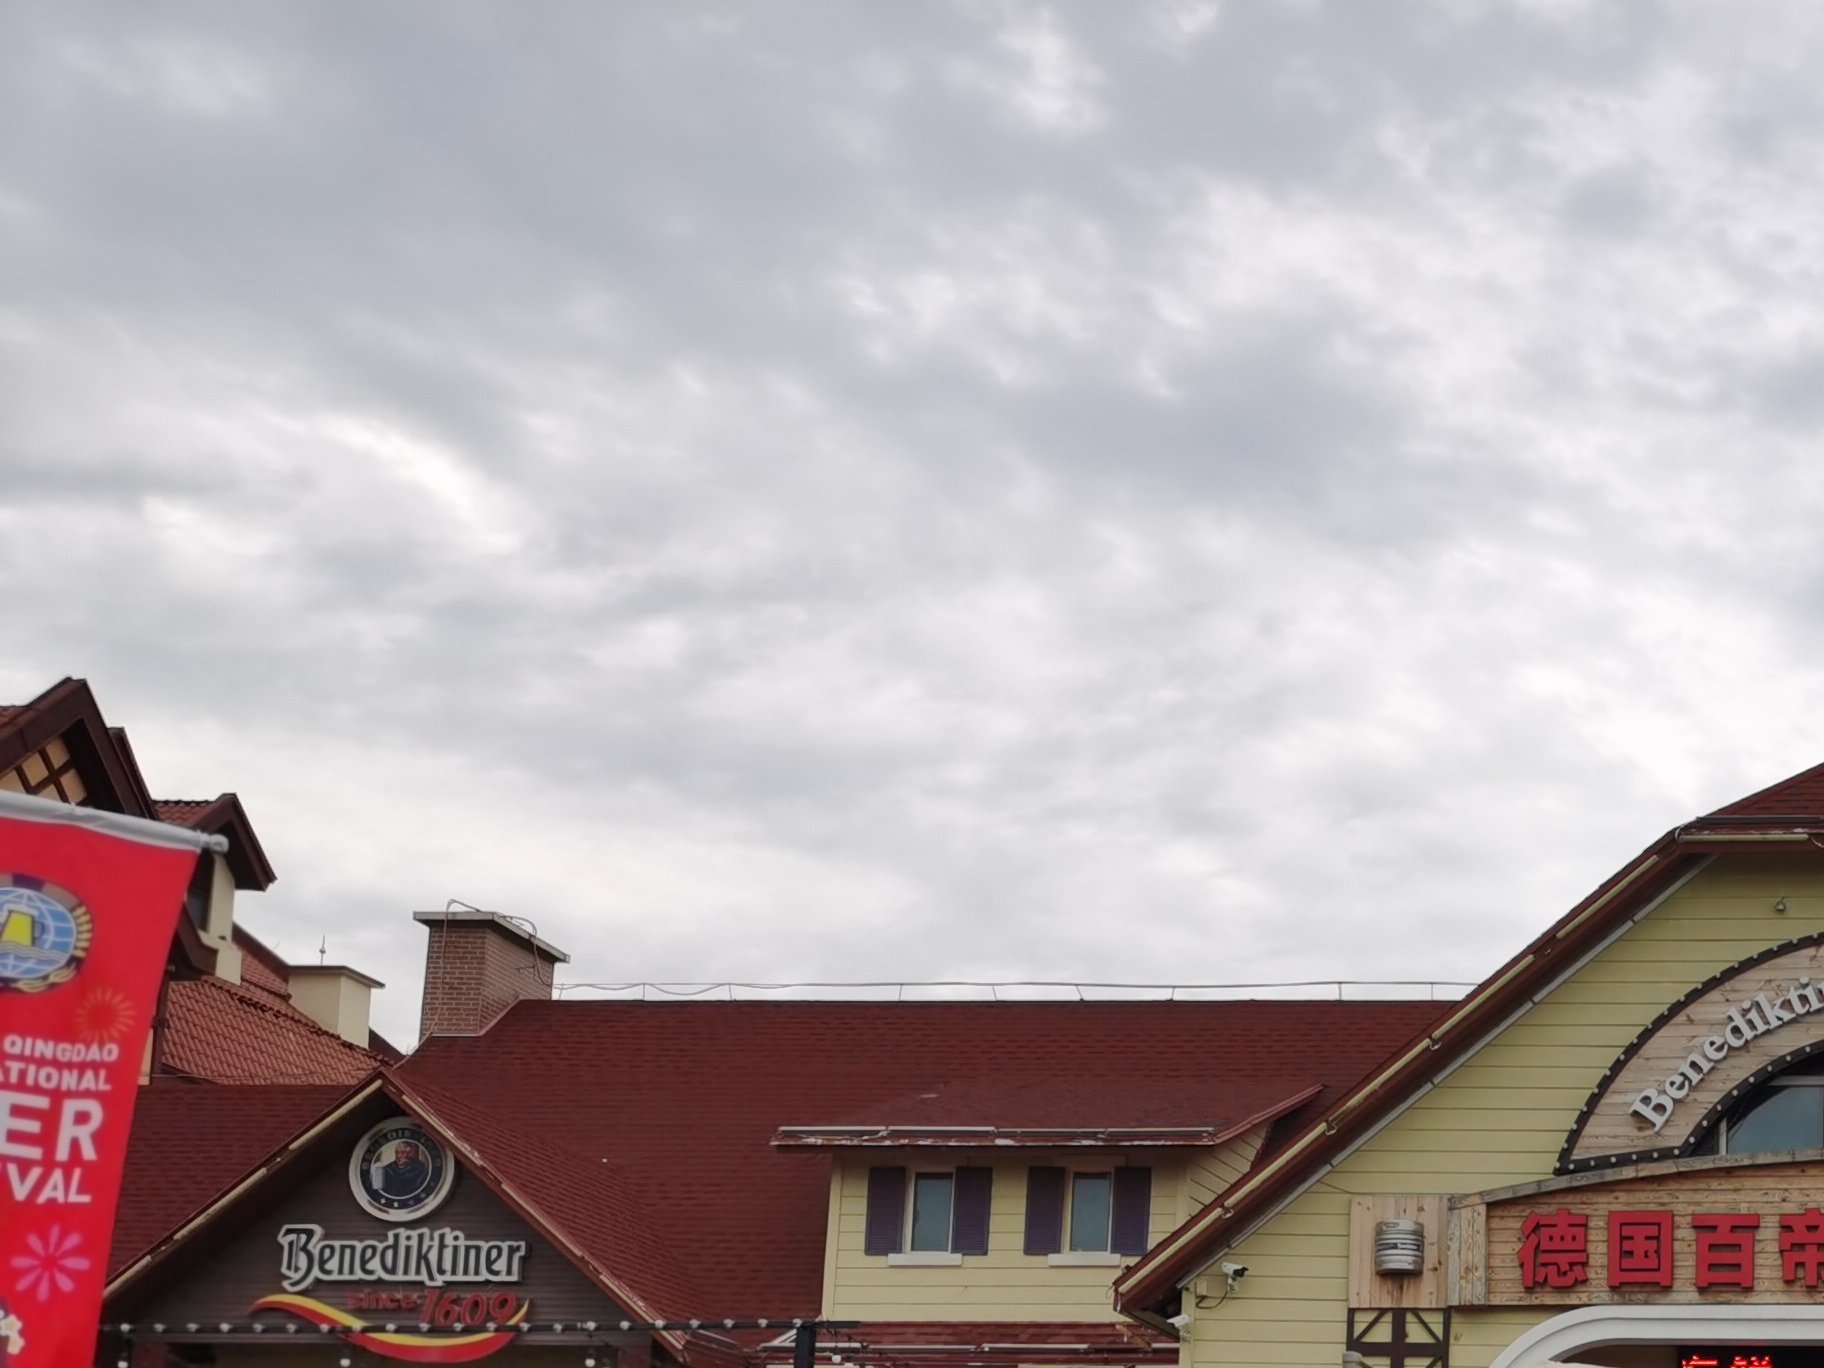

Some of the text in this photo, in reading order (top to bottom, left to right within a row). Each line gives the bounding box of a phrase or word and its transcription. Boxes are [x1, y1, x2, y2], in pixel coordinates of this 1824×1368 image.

[4, 1034, 120, 1063] QINGDAO
[0, 1162, 92, 1204] VAL
[278, 1224, 526, 1292] Benediktiner
[420, 1288, 517, 1326] 1609
